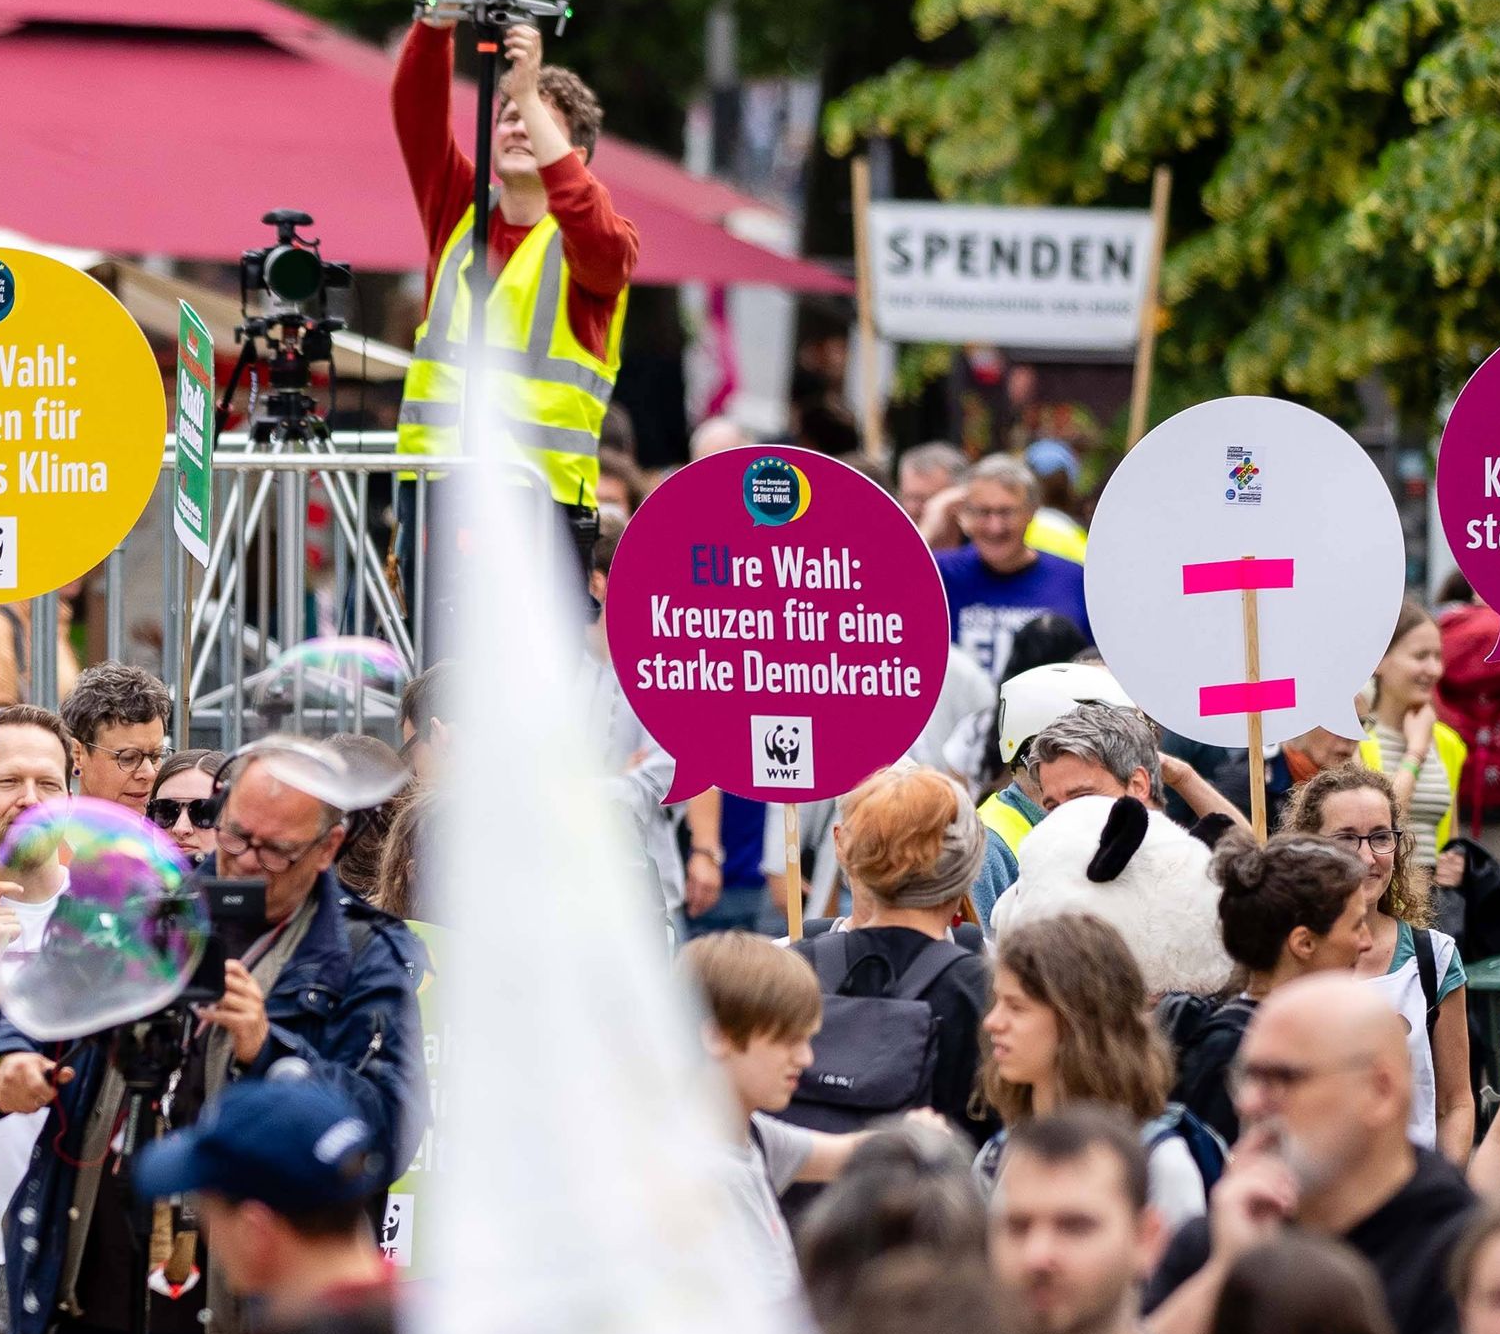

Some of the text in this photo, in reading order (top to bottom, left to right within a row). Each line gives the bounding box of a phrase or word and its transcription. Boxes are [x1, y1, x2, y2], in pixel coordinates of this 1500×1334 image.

[887, 224, 1135, 286] SPENDEN
[33, 398, 82, 442] für
[17, 452, 109, 494] Klima
[753, 493, 791, 504] DEINE WAHL
[691, 544, 862, 590] EUre Wahl:
[651, 595, 903, 644] Kreuzen für eine
[637, 649, 734, 691] starke
[744, 650, 921, 698] Demokratie
[767, 768, 801, 780] WWF
